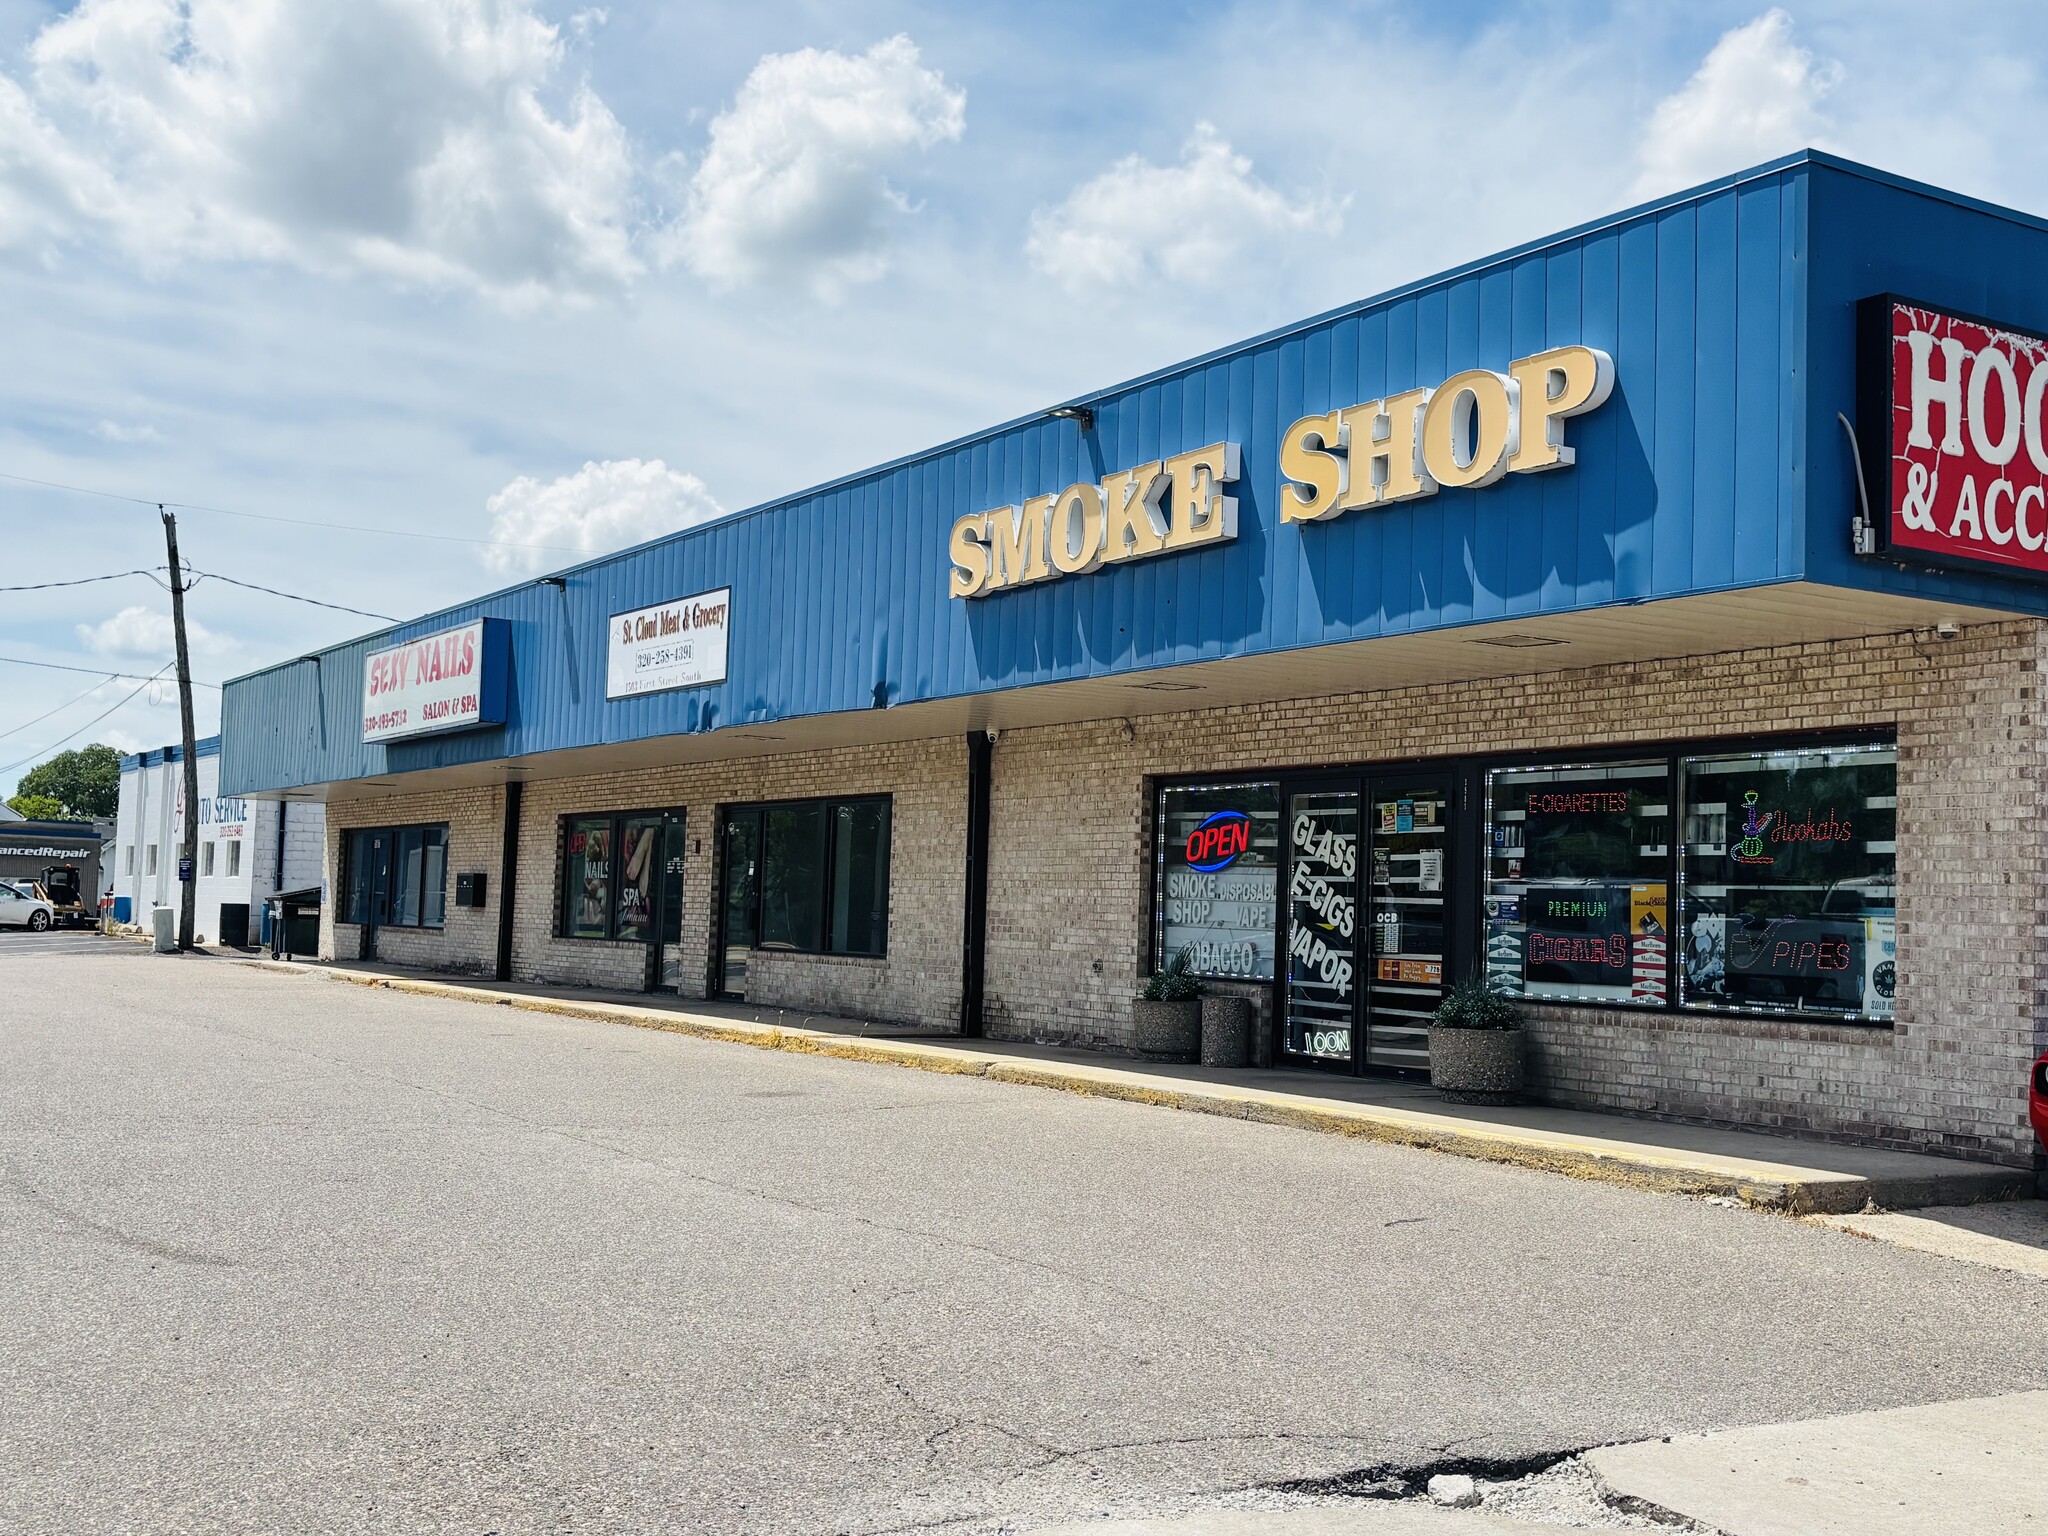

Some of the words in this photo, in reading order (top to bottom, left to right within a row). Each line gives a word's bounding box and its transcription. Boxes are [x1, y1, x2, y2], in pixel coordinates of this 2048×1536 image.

[949, 441, 1240, 599] SMOKE
[1280, 345, 1614, 525] SHOP
[1902, 463, 1937, 532] &
[1950, 474, 2048, 553] ACC
[623, 620, 633, 644] St.
[636, 613, 658, 641] Cloud
[660, 610, 680, 638] Meat
[683, 605, 690, 632] &
[693, 603, 726, 630] Grocery
[370, 650, 411, 697] SEXY
[416, 630, 475, 686] NAILS
[681, 670, 701, 684] South
[422, 699, 450, 721] SALON
[461, 694, 477, 715] SPA
[215, 798, 247, 823] SERVICE
[1529, 792, 1627, 813] E-CIGARETTES
[1771, 807, 1852, 842] Hookahs
[1186, 821, 1250, 862] OPEN
[1292, 814, 1356, 877] GLASS
[585, 861, 608, 879] NAILS
[623, 888, 640, 906] SPA
[1169, 874, 1216, 898] SMOKE
[1220, 883, 1276, 900] DISPOSABL
[1173, 900, 1210, 924] SHOP
[1291, 861, 1354, 938] E-CIGS
[1237, 906, 1266, 928] VAPE
[1377, 913, 1397, 923] OCB
[1290, 918, 1353, 998] VAPOR
[1772, 941, 1851, 970] PIPES
[1876, 985, 1895, 997] GLOB
[1871, 1000, 1887, 1011] SOLD
